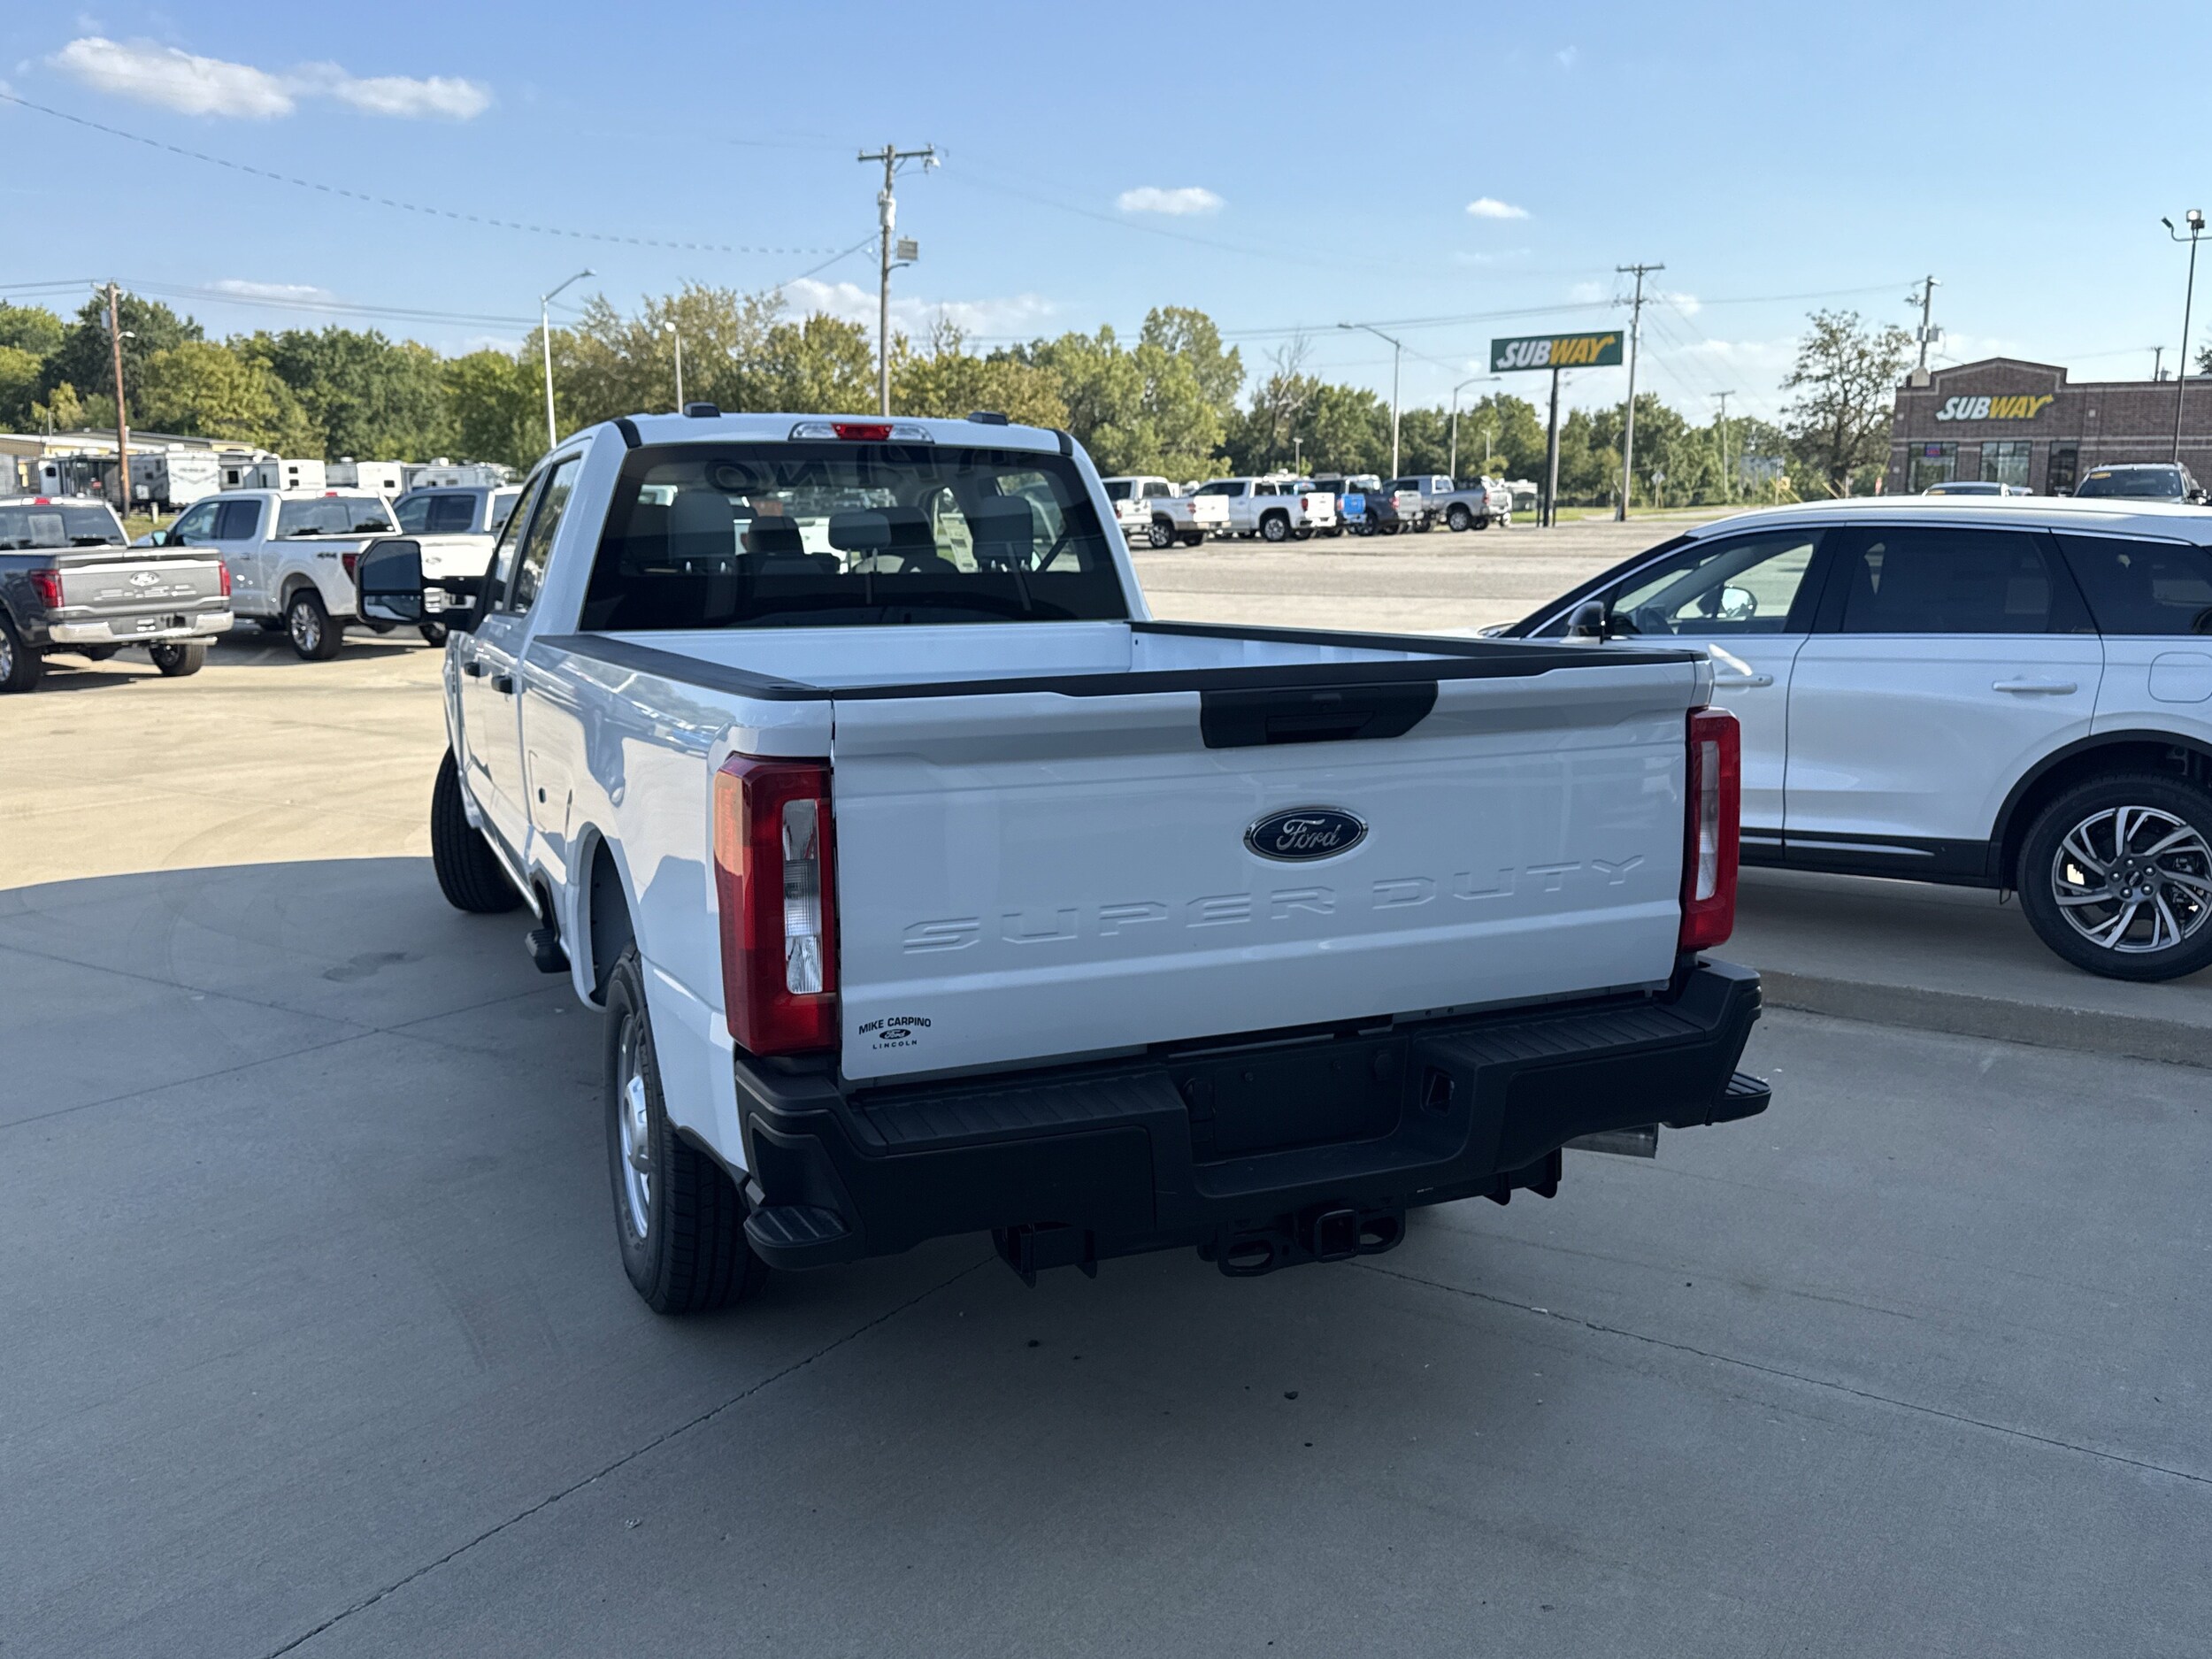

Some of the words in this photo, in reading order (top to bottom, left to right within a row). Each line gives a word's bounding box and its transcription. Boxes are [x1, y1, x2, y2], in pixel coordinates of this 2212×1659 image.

[1495, 334, 1616, 369] SUBWAY
[1935, 394, 2054, 421] SUBWAY
[1276, 818, 1341, 850] Ford
[903, 886, 1334, 954] SUPER
[1372, 855, 1644, 910] DUTY
[858, 1019, 884, 1035] MIKE
[887, 1017, 932, 1027] CARPINO
[882, 1029, 908, 1039] Ford
[872, 1040, 918, 1049] LINCOLN
